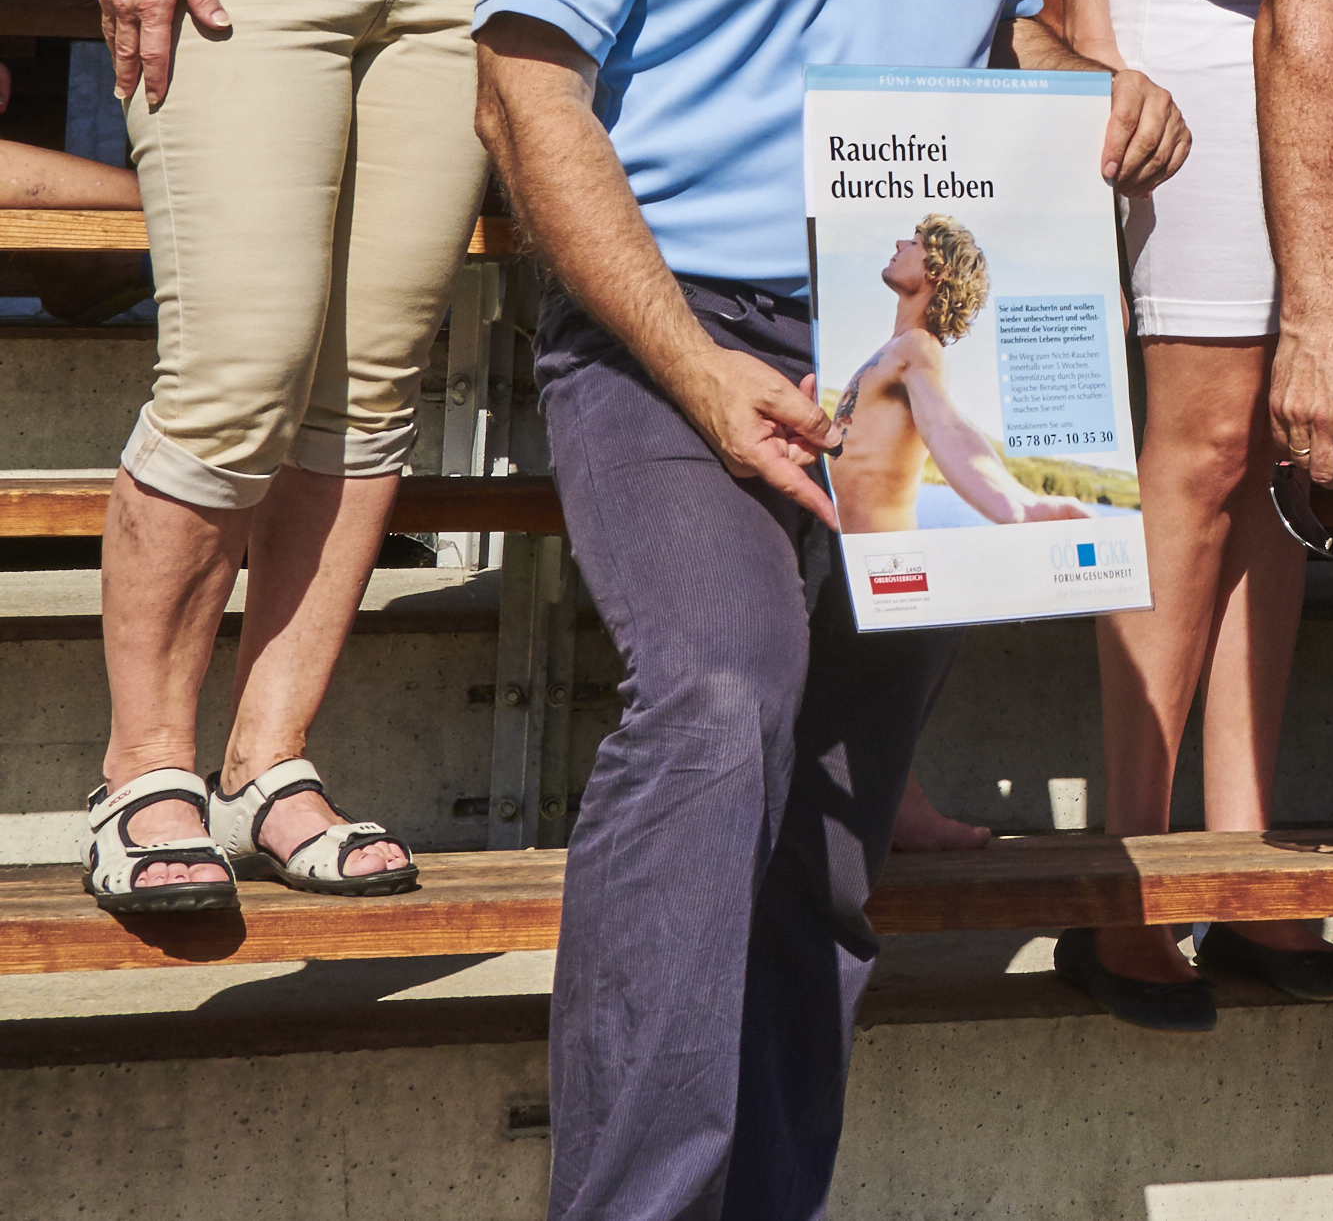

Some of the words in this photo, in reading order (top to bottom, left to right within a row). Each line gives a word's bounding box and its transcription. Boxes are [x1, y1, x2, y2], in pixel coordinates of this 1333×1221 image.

[879, 73, 1049, 90] FÜNF-WOCHEN-PROGRAMM
[829, 134, 948, 162] Rauchfrei
[831, 171, 914, 199] durchs
[923, 172, 995, 199] Leben
[1010, 304, 1024, 312] sind
[1025, 304, 1058, 312] RaucherIn
[1000, 315, 1021, 323] wieder
[1023, 314, 1064, 323] unbeschwert
[1065, 314, 1078, 322] und
[1079, 313, 1100, 321] selbst-
[1000, 325, 1030, 333] bestimmt
[1043, 325, 1069, 334] Vorzüge
[1070, 324, 1087, 332] eines
[1000, 336, 1038, 344] rauchfreien
[1039, 335, 1061, 343] Lebens
[1020, 353, 1035, 362] Weg
[1009, 363, 1041, 371] innerhalb
[1057, 372, 1076, 380] durch
[1069, 382, 1076, 390] in
[1012, 395, 1029, 403] Auch
[1030, 394, 1040, 402] Sie
[1042, 393, 1067, 402] können
[1013, 405, 1039, 413] machen
[1040, 404, 1051, 412] Sie
[1007, 421, 1047, 431] Kontaktieren
[1049, 421, 1059, 429] Sie
[1008, 435, 1022, 448] 05
[1026, 435, 1040, 447] 78
[1066, 432, 1079, 445] 10
[1082, 432, 1096, 444] 35
[1099, 431, 1114, 443] 30
[1054, 573, 1082, 583] FORUM
[1082, 568, 1132, 581] GESUNDHEIT
